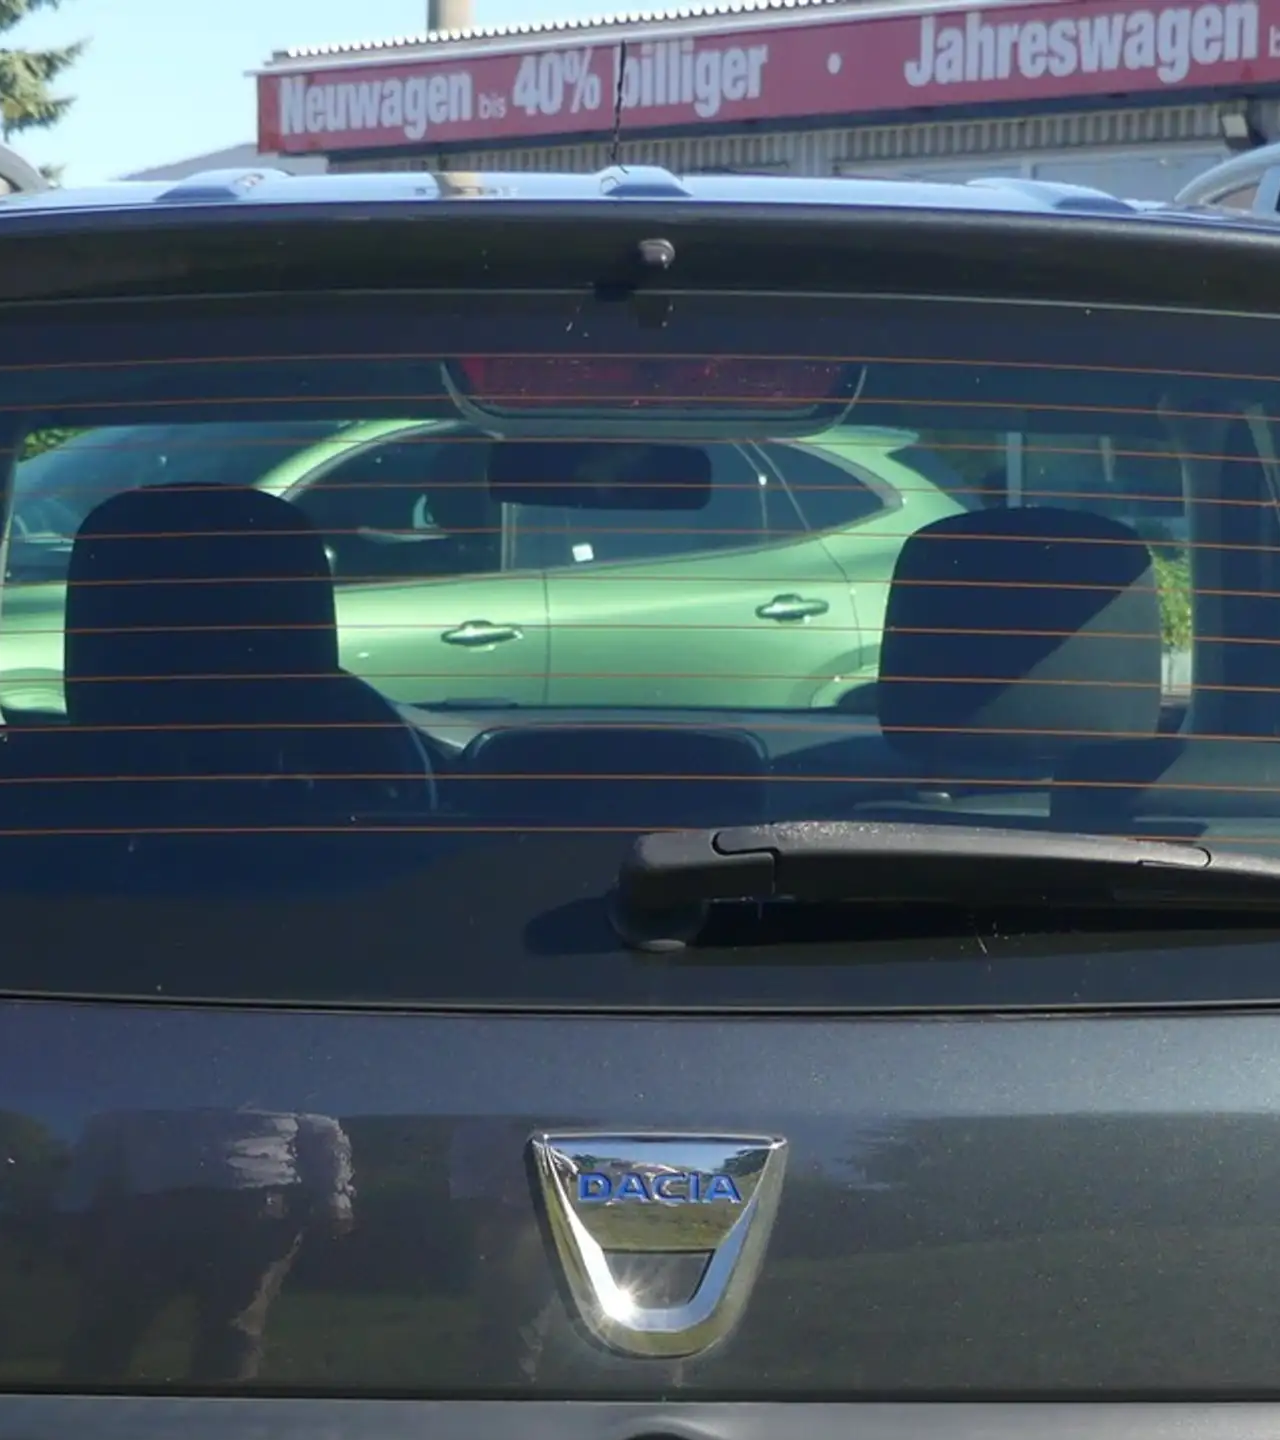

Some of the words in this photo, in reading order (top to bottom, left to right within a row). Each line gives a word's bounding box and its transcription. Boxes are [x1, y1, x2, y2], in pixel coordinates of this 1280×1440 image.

[280, 71, 473, 138] Neuwagen
[479, 93, 506, 119] bis
[512, 48, 601, 115] 40%
[615, 40, 769, 118] billiger
[904, 2, 1258, 88] Jahreswagen
[577, 1171, 742, 1203] DACIA
